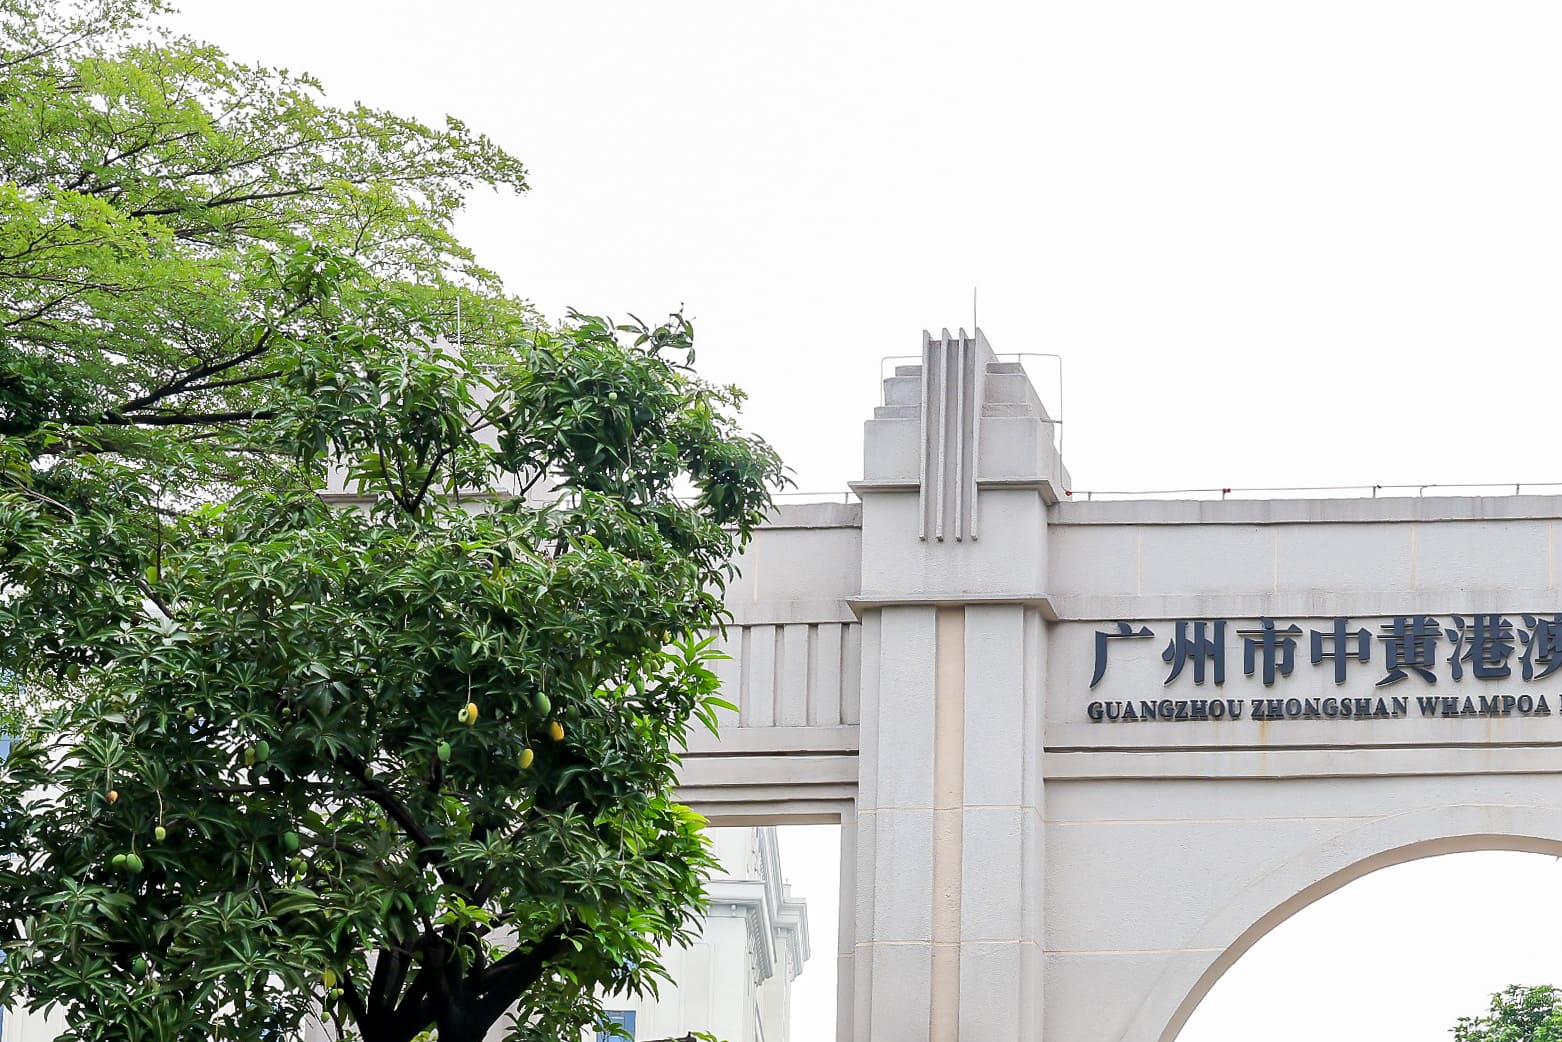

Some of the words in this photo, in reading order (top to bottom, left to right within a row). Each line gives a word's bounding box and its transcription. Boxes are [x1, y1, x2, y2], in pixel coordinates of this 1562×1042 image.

[1087, 699, 1245, 721] GUANGZHOU
[1251, 697, 1409, 720] ZHONGSHAN
[1416, 694, 1552, 717] WHAMPOA
